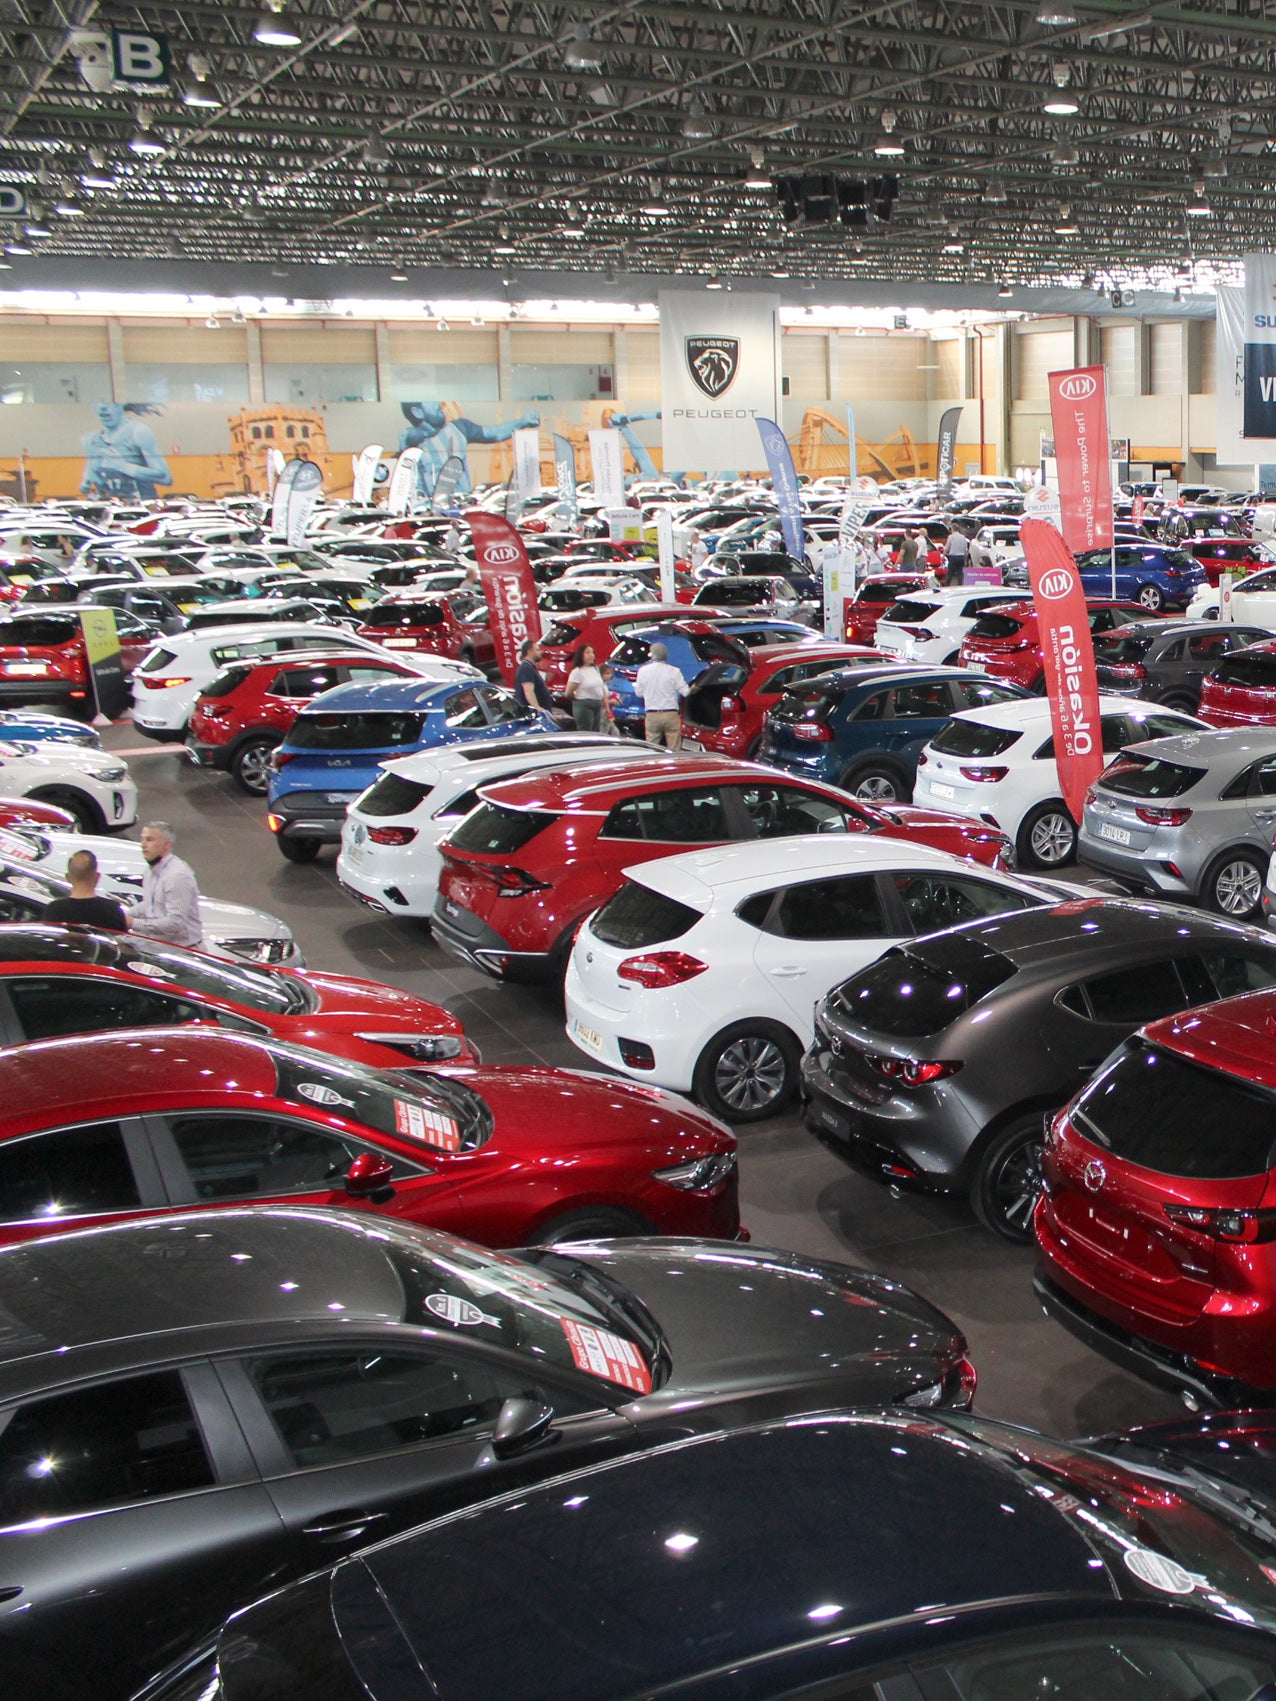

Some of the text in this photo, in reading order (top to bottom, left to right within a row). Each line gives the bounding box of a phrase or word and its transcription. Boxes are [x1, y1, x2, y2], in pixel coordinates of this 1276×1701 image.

[118, 32, 164, 79] B
[690, 340, 736, 348] PEUGEOT
[672, 408, 758, 419] PEUGEOT
[940, 431, 952, 489] SPOTICAR
